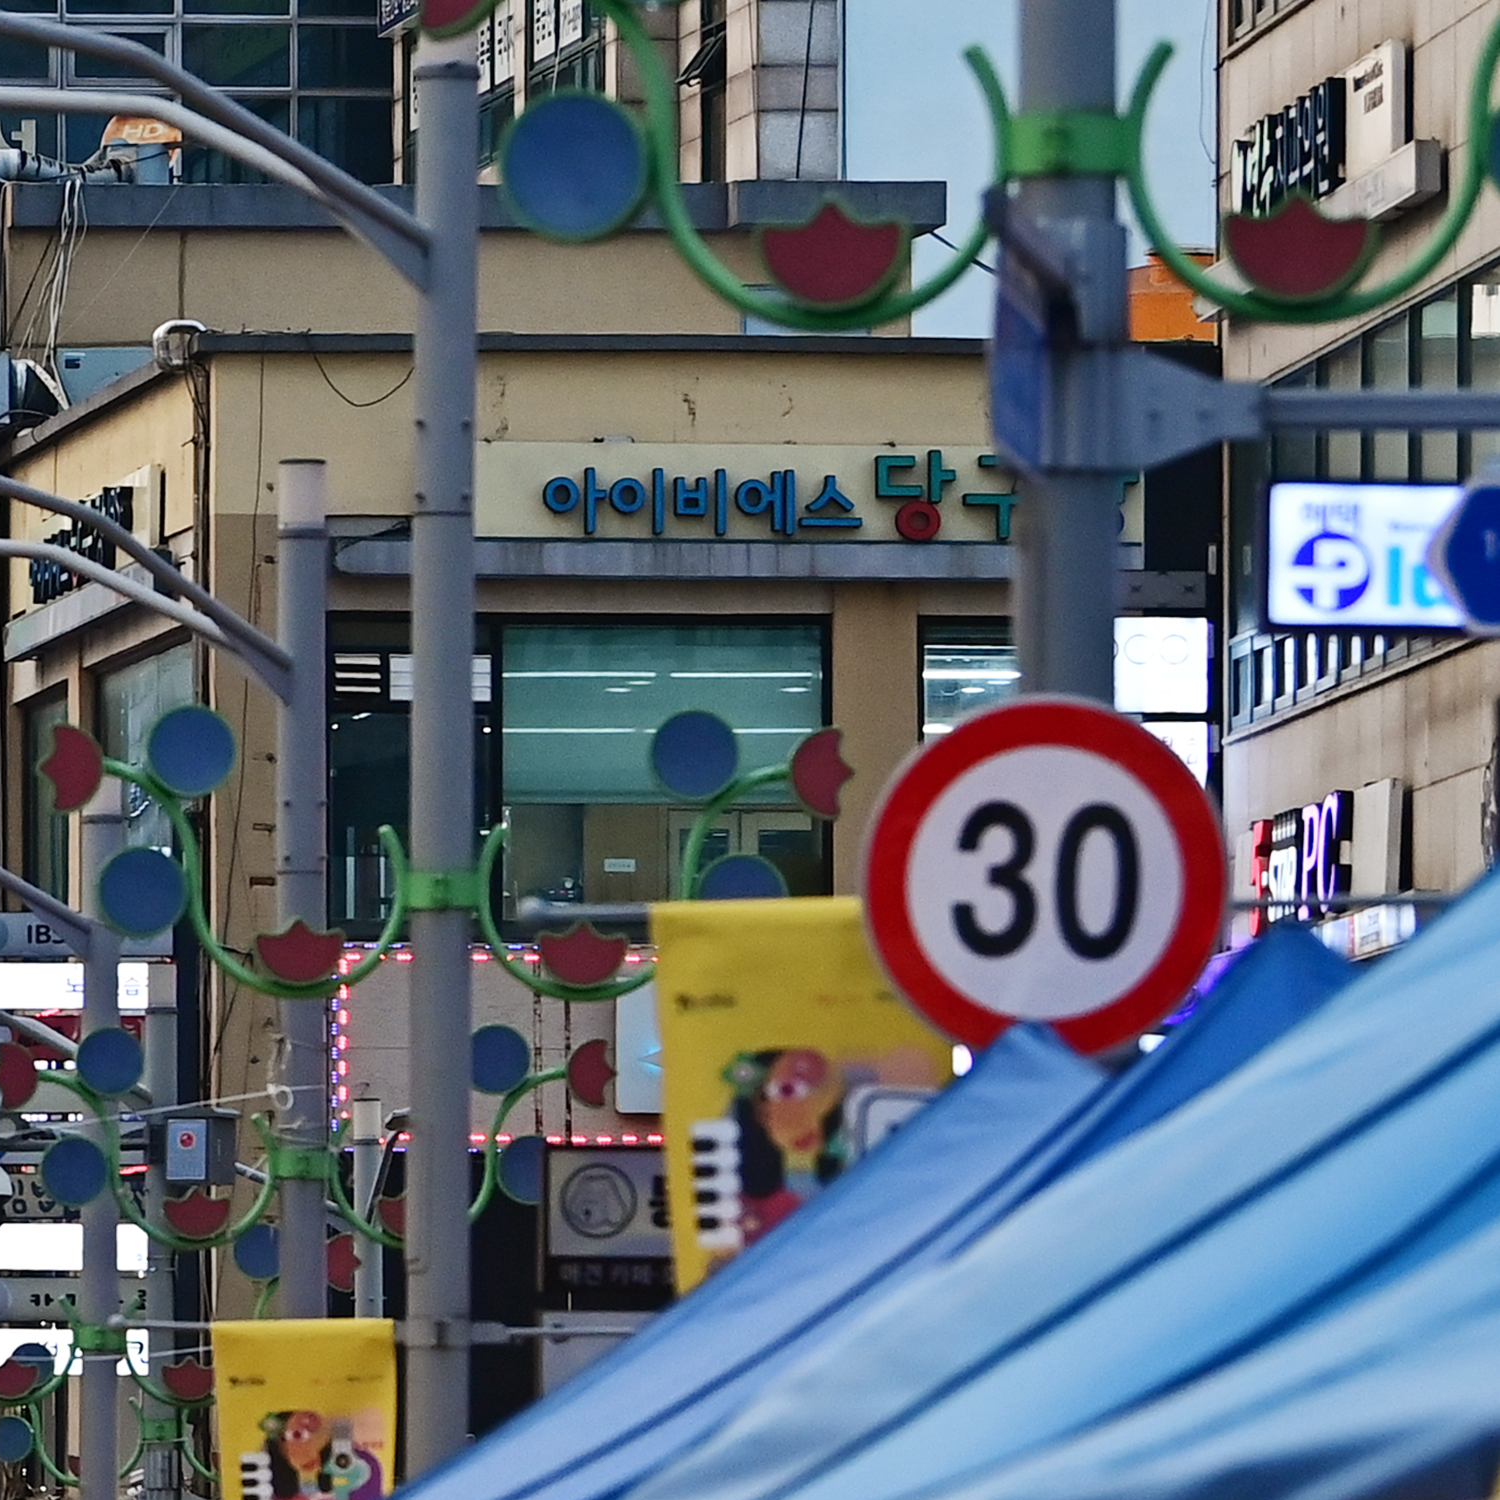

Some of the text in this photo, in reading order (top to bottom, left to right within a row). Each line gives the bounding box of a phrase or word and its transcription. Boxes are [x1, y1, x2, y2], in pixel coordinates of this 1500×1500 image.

[121, 124, 164, 138] HD
[542, 466, 863, 537] 아이비에스
[952, 801, 1141, 959] 30
[1298, 793, 1339, 921] PC
